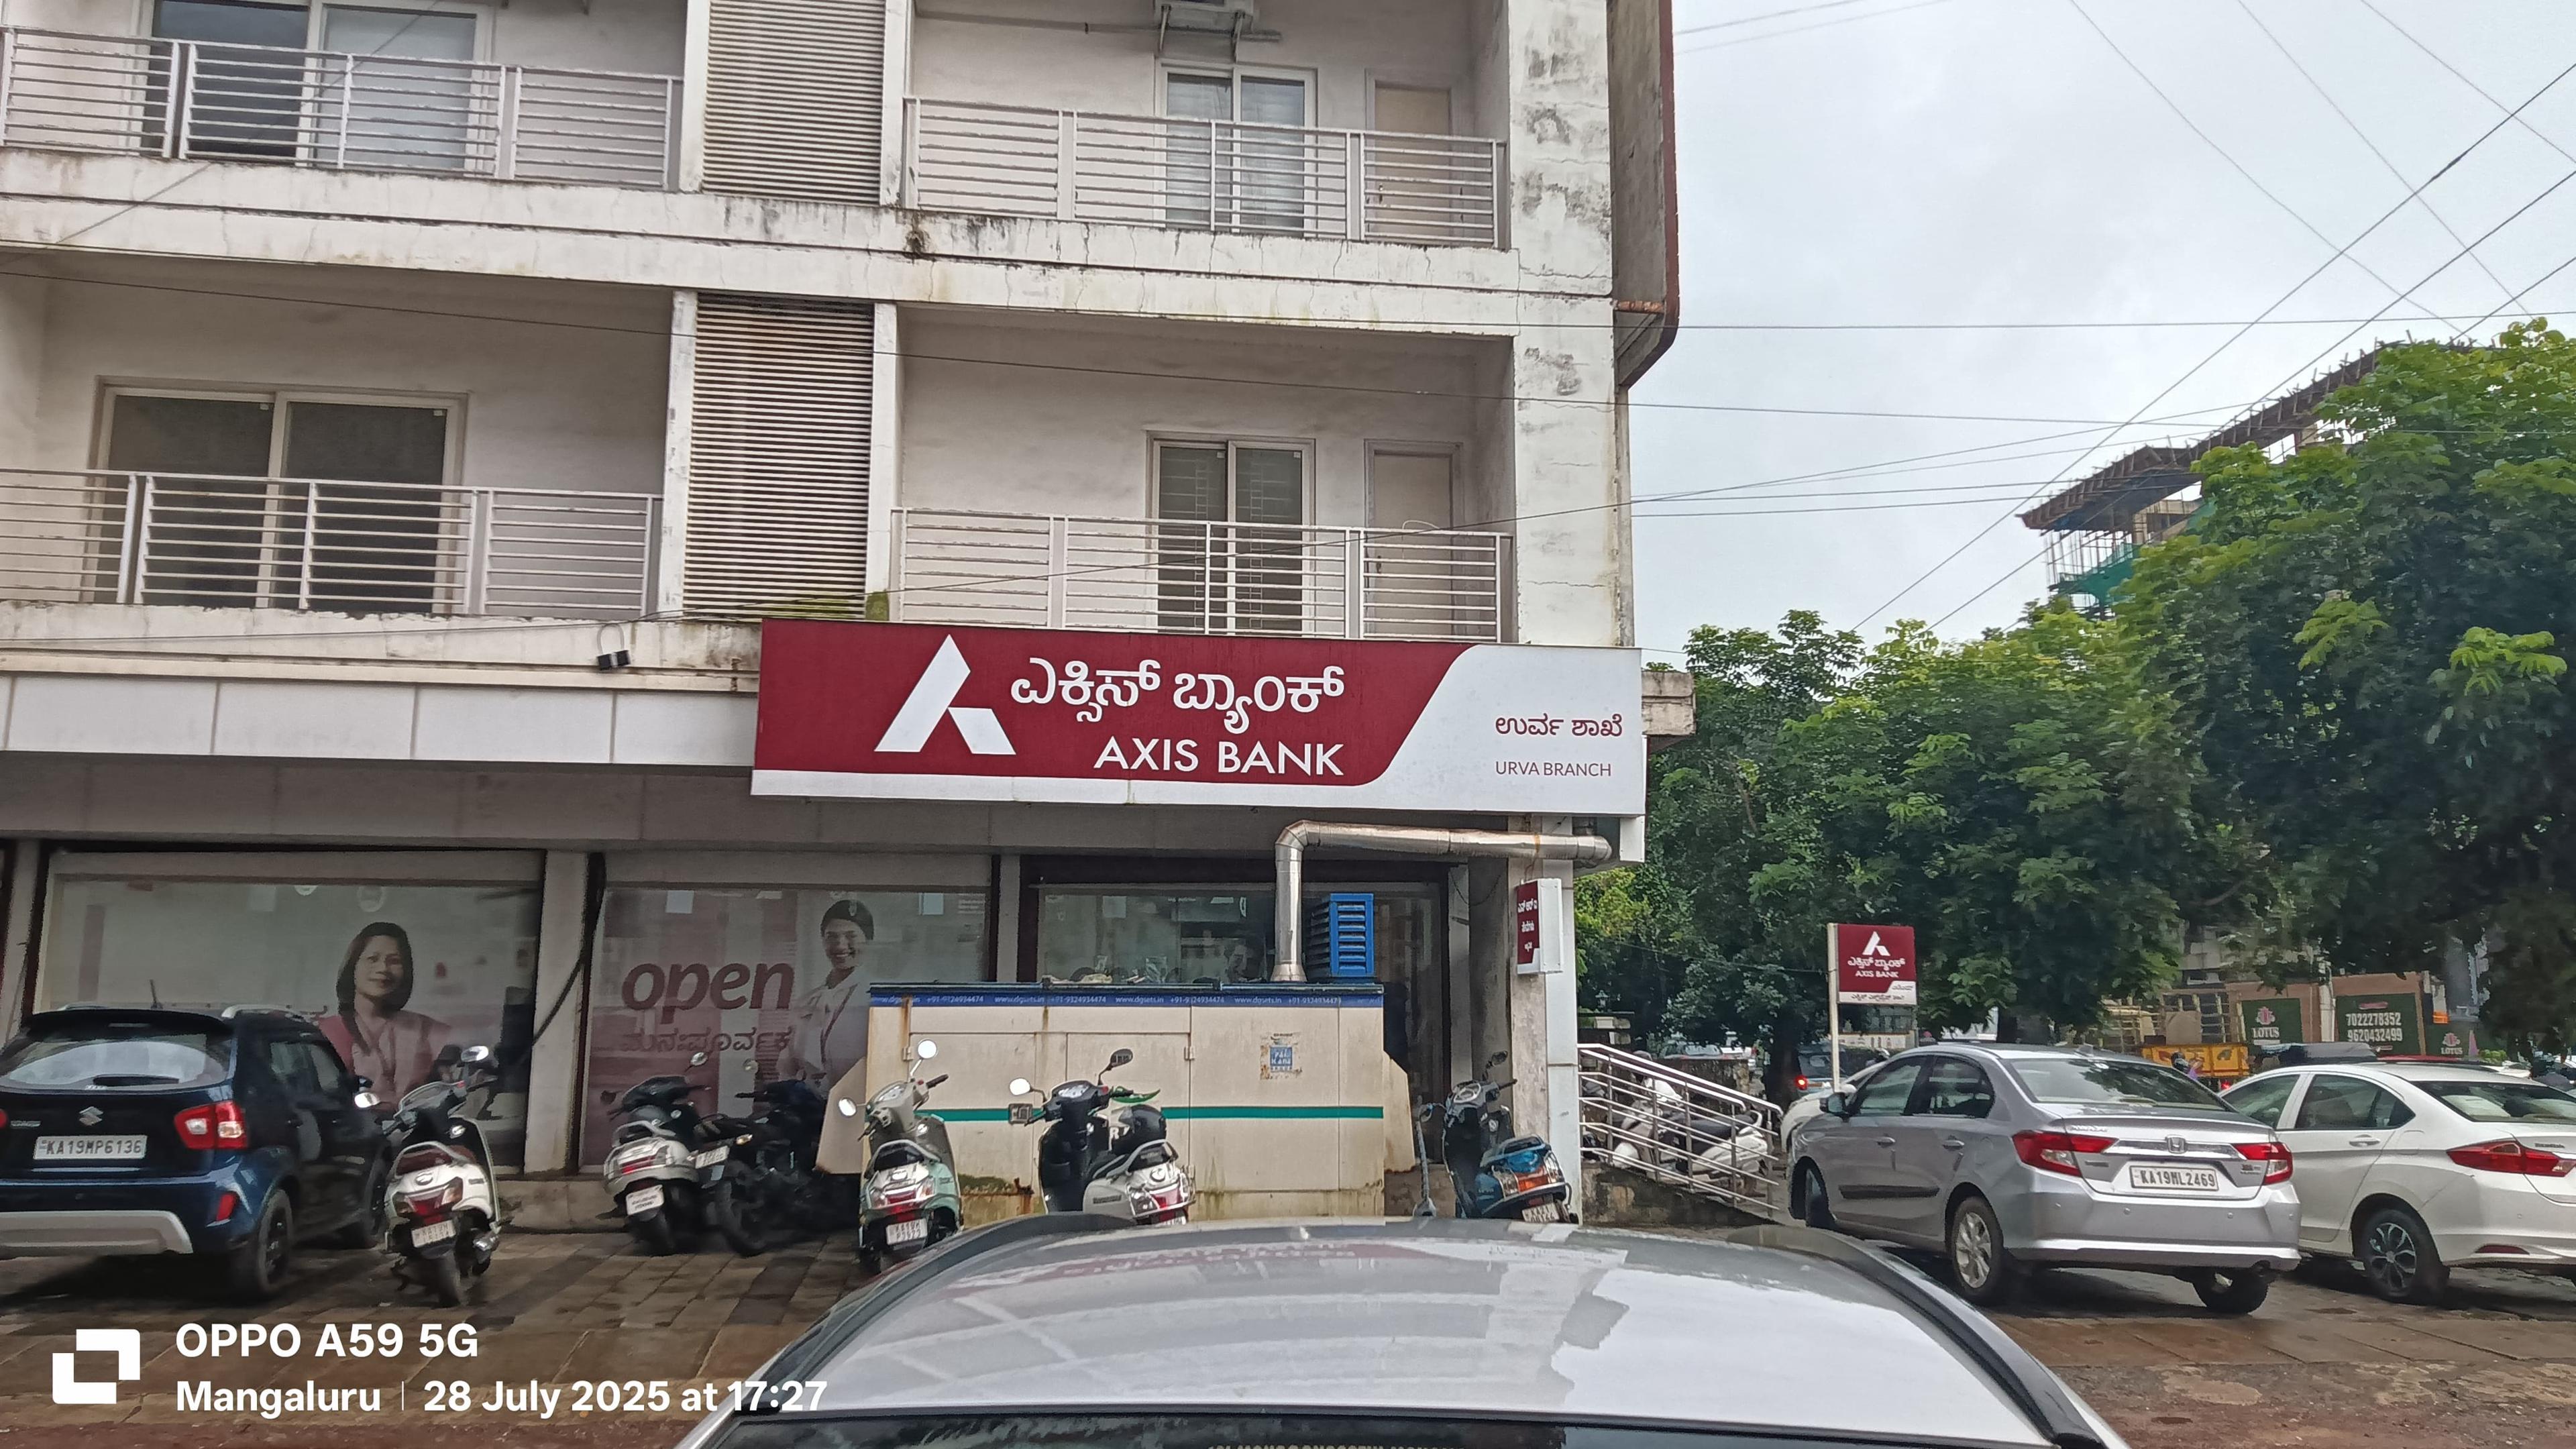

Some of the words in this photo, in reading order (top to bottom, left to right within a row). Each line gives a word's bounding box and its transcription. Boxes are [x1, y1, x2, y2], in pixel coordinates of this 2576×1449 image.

[1011, 657, 1161, 722] ಎಕ್ಸಿಸ್
[1173, 665, 1344, 735] ಬ್ಯಾಂಕ್
[1571, 714, 1623, 737] ಶಾಖೆ
[1093, 736, 1199, 772] AXIS
[1218, 741, 1344, 775] BANK
[1496, 761, 1540, 775] URVA
[1544, 762, 1611, 777] BRANCH
[622, 963, 794, 1024] open
[1116, 996, 1164, 1005] www.dgsets.in
[1234, 996, 1282, 1005] www.dgsets.in
[2252, 1027, 2279, 1038] LOTUS
[2347, 1028, 2403, 1041] 9620432499
